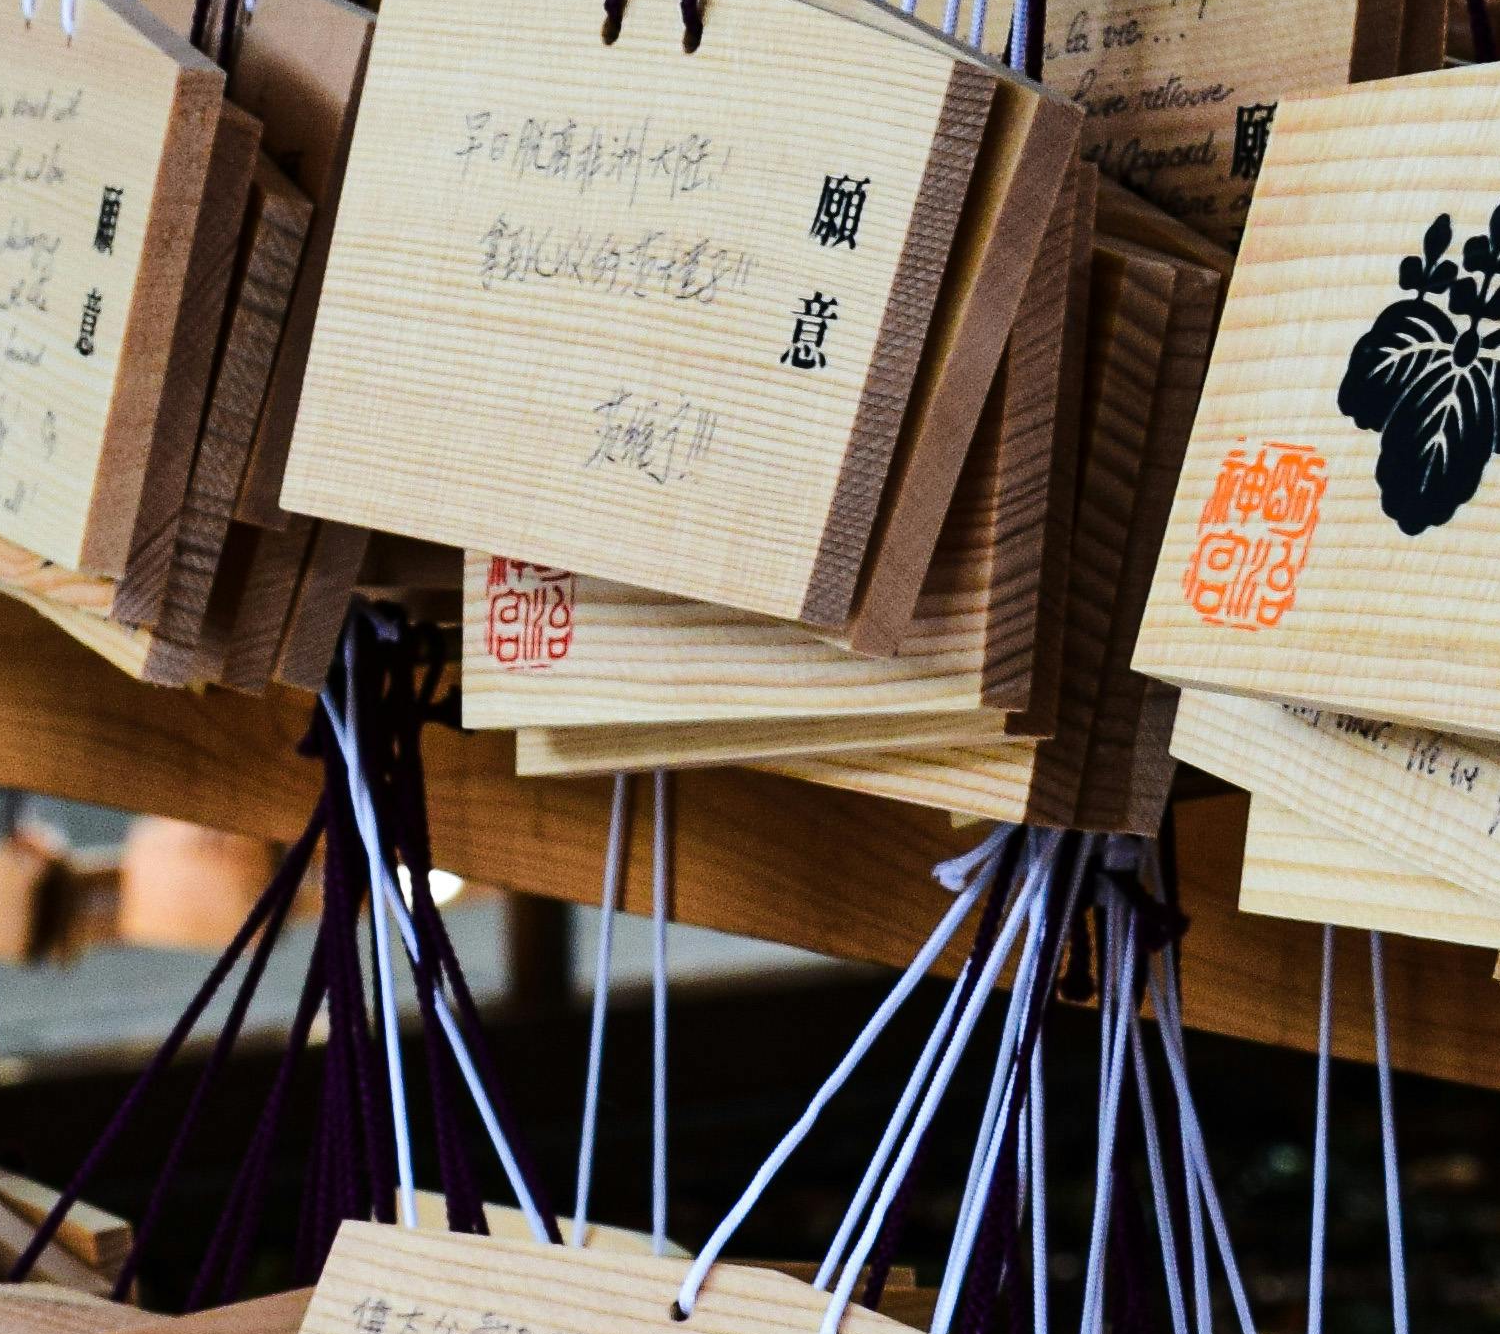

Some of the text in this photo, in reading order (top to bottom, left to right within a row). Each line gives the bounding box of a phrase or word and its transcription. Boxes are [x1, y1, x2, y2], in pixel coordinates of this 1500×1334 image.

[73, 184, 125, 358] 願意
[779, 173, 872, 370] 願意
[1181, 435, 1330, 631] 明治神宮
